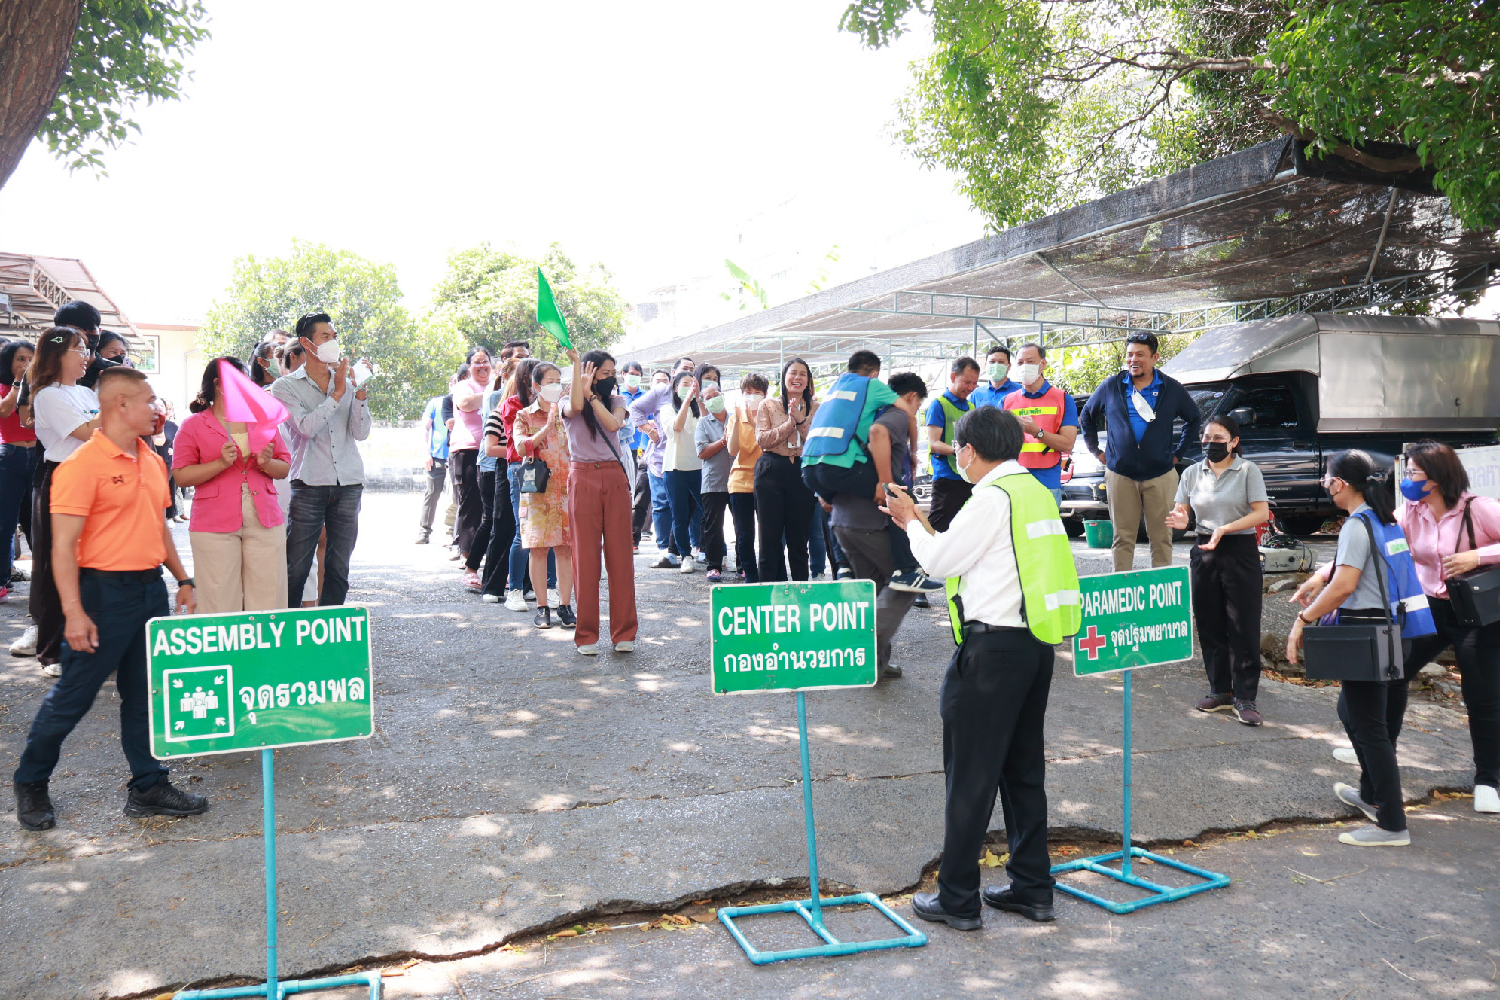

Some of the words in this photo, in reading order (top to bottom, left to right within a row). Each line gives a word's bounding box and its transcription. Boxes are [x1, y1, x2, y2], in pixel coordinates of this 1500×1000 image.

[1149, 580, 1182, 609] POINT
[153, 621, 286, 657] ASSEMBLY
[296, 616, 366, 646] POINT
[718, 604, 801, 636] CENTER
[809, 601, 870, 632] POINT
[1110, 620, 1188, 657] จุดปฐมพยาบาล
[723, 642, 866, 673] กองอำนวยการ
[238, 676, 365, 725] จุดรวมพล
